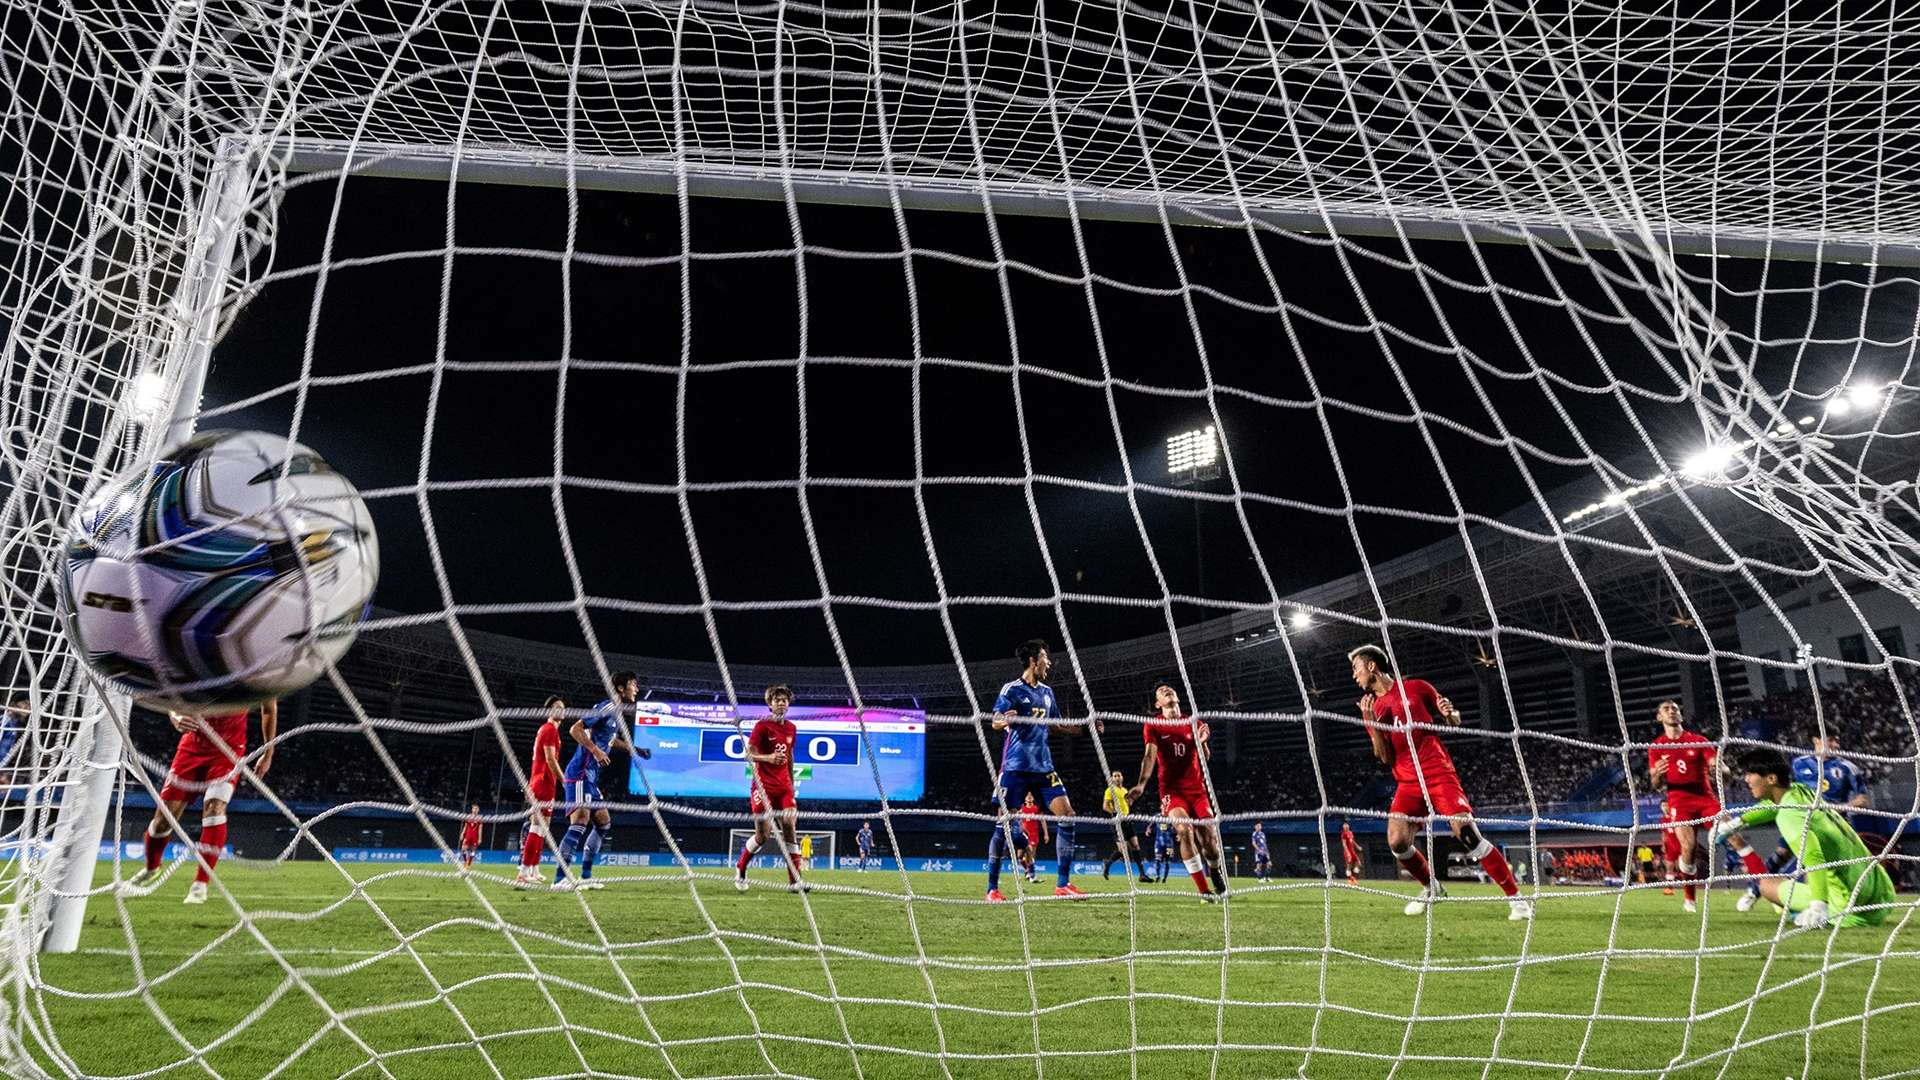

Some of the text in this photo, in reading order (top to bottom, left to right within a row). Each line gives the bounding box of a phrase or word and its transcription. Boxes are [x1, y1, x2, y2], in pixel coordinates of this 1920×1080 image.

[724, 734, 750, 760] 0
[808, 736, 837, 761] 0
[879, 747, 902, 755] Blue
[1173, 742, 1186, 757] 10
[840, 857, 882, 866] BORAN
